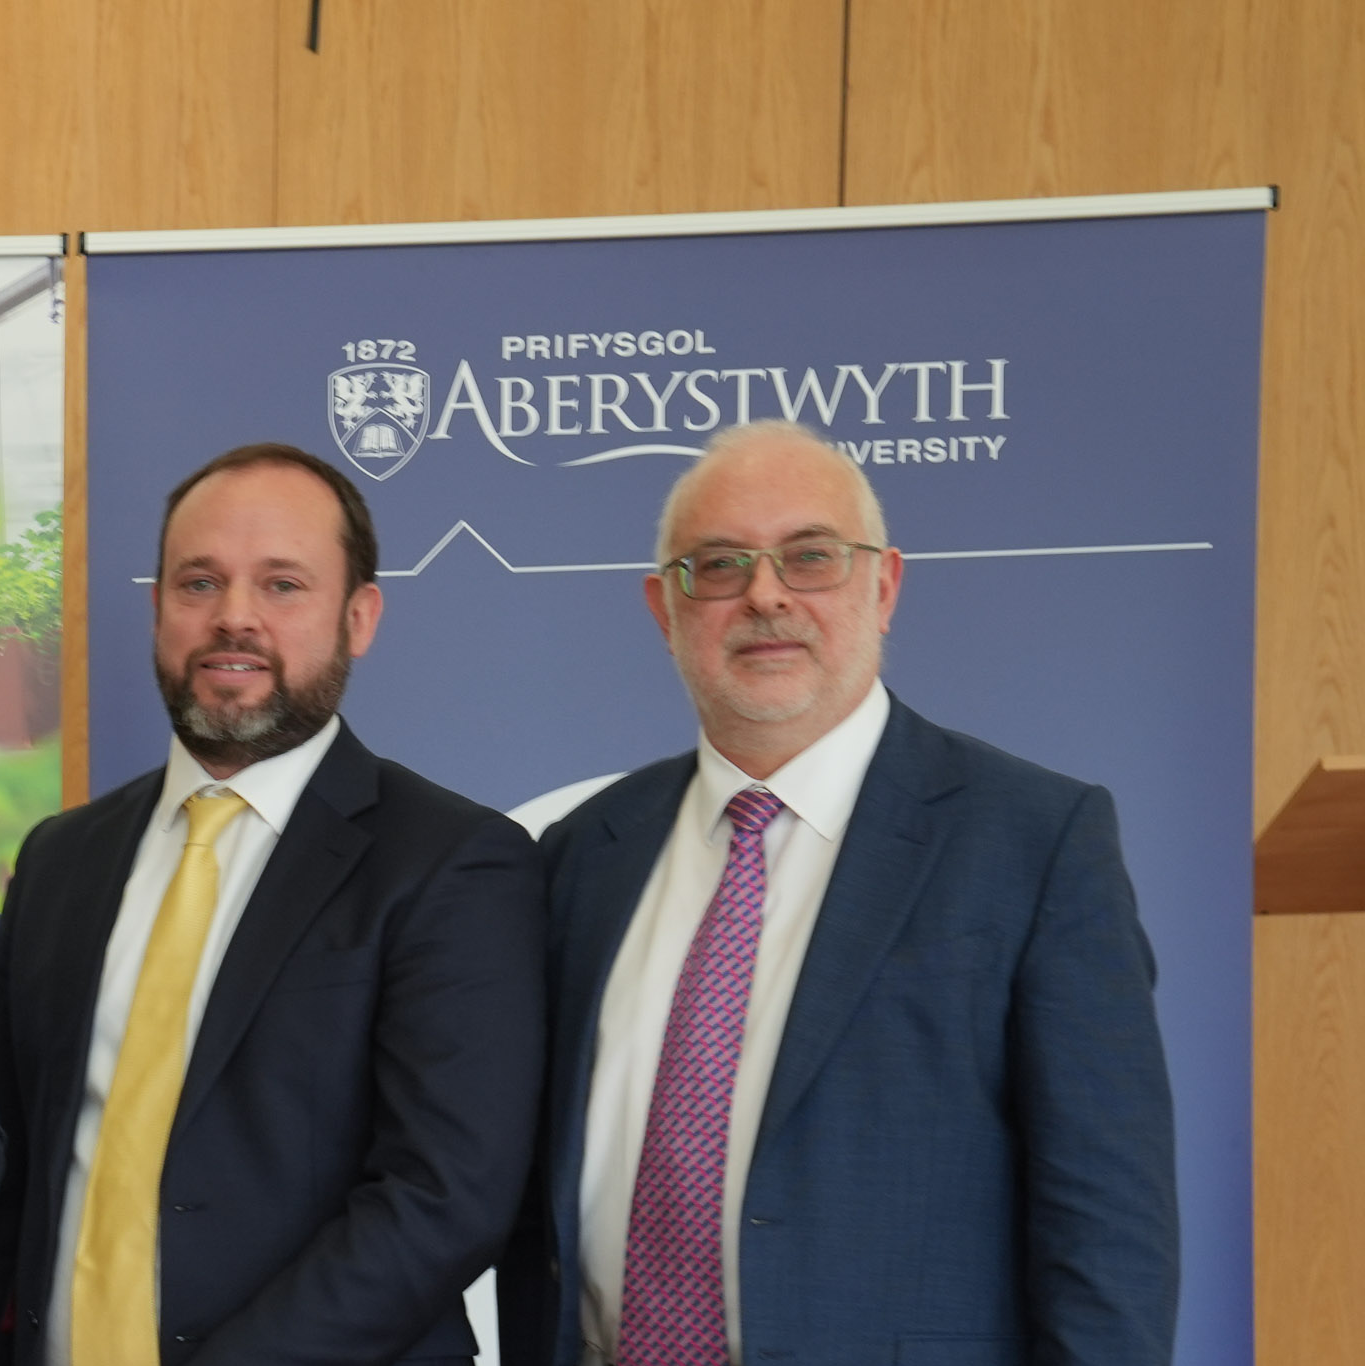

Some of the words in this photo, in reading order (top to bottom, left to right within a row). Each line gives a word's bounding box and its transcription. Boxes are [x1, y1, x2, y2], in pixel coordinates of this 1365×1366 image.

[341, 338, 417, 363] 1872
[501, 329, 716, 361] PRIFYSGOL
[425, 357, 1012, 467] ABERYSTWYTH
[836, 434, 1007, 466] VERSITY
